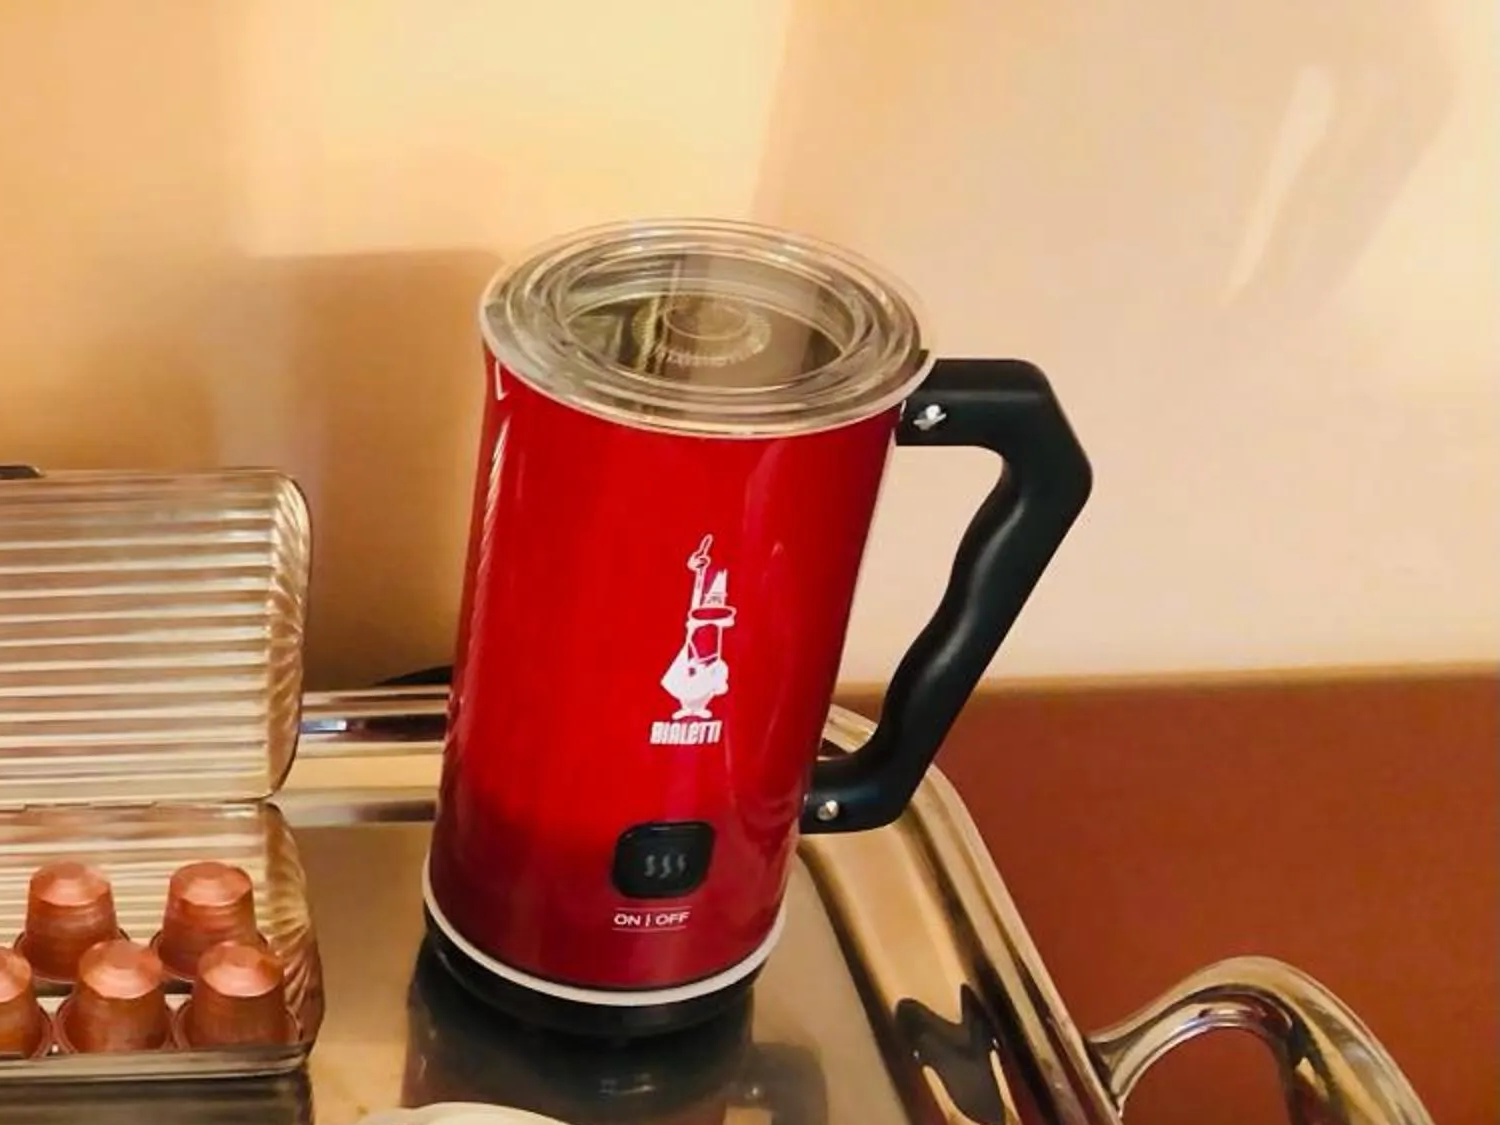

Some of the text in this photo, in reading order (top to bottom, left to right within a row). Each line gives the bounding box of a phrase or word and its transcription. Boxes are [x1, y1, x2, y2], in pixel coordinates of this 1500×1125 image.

[650, 719, 723, 745] BIALETTI
[613, 912, 641, 926] ON
[655, 911, 692, 926] OFF
